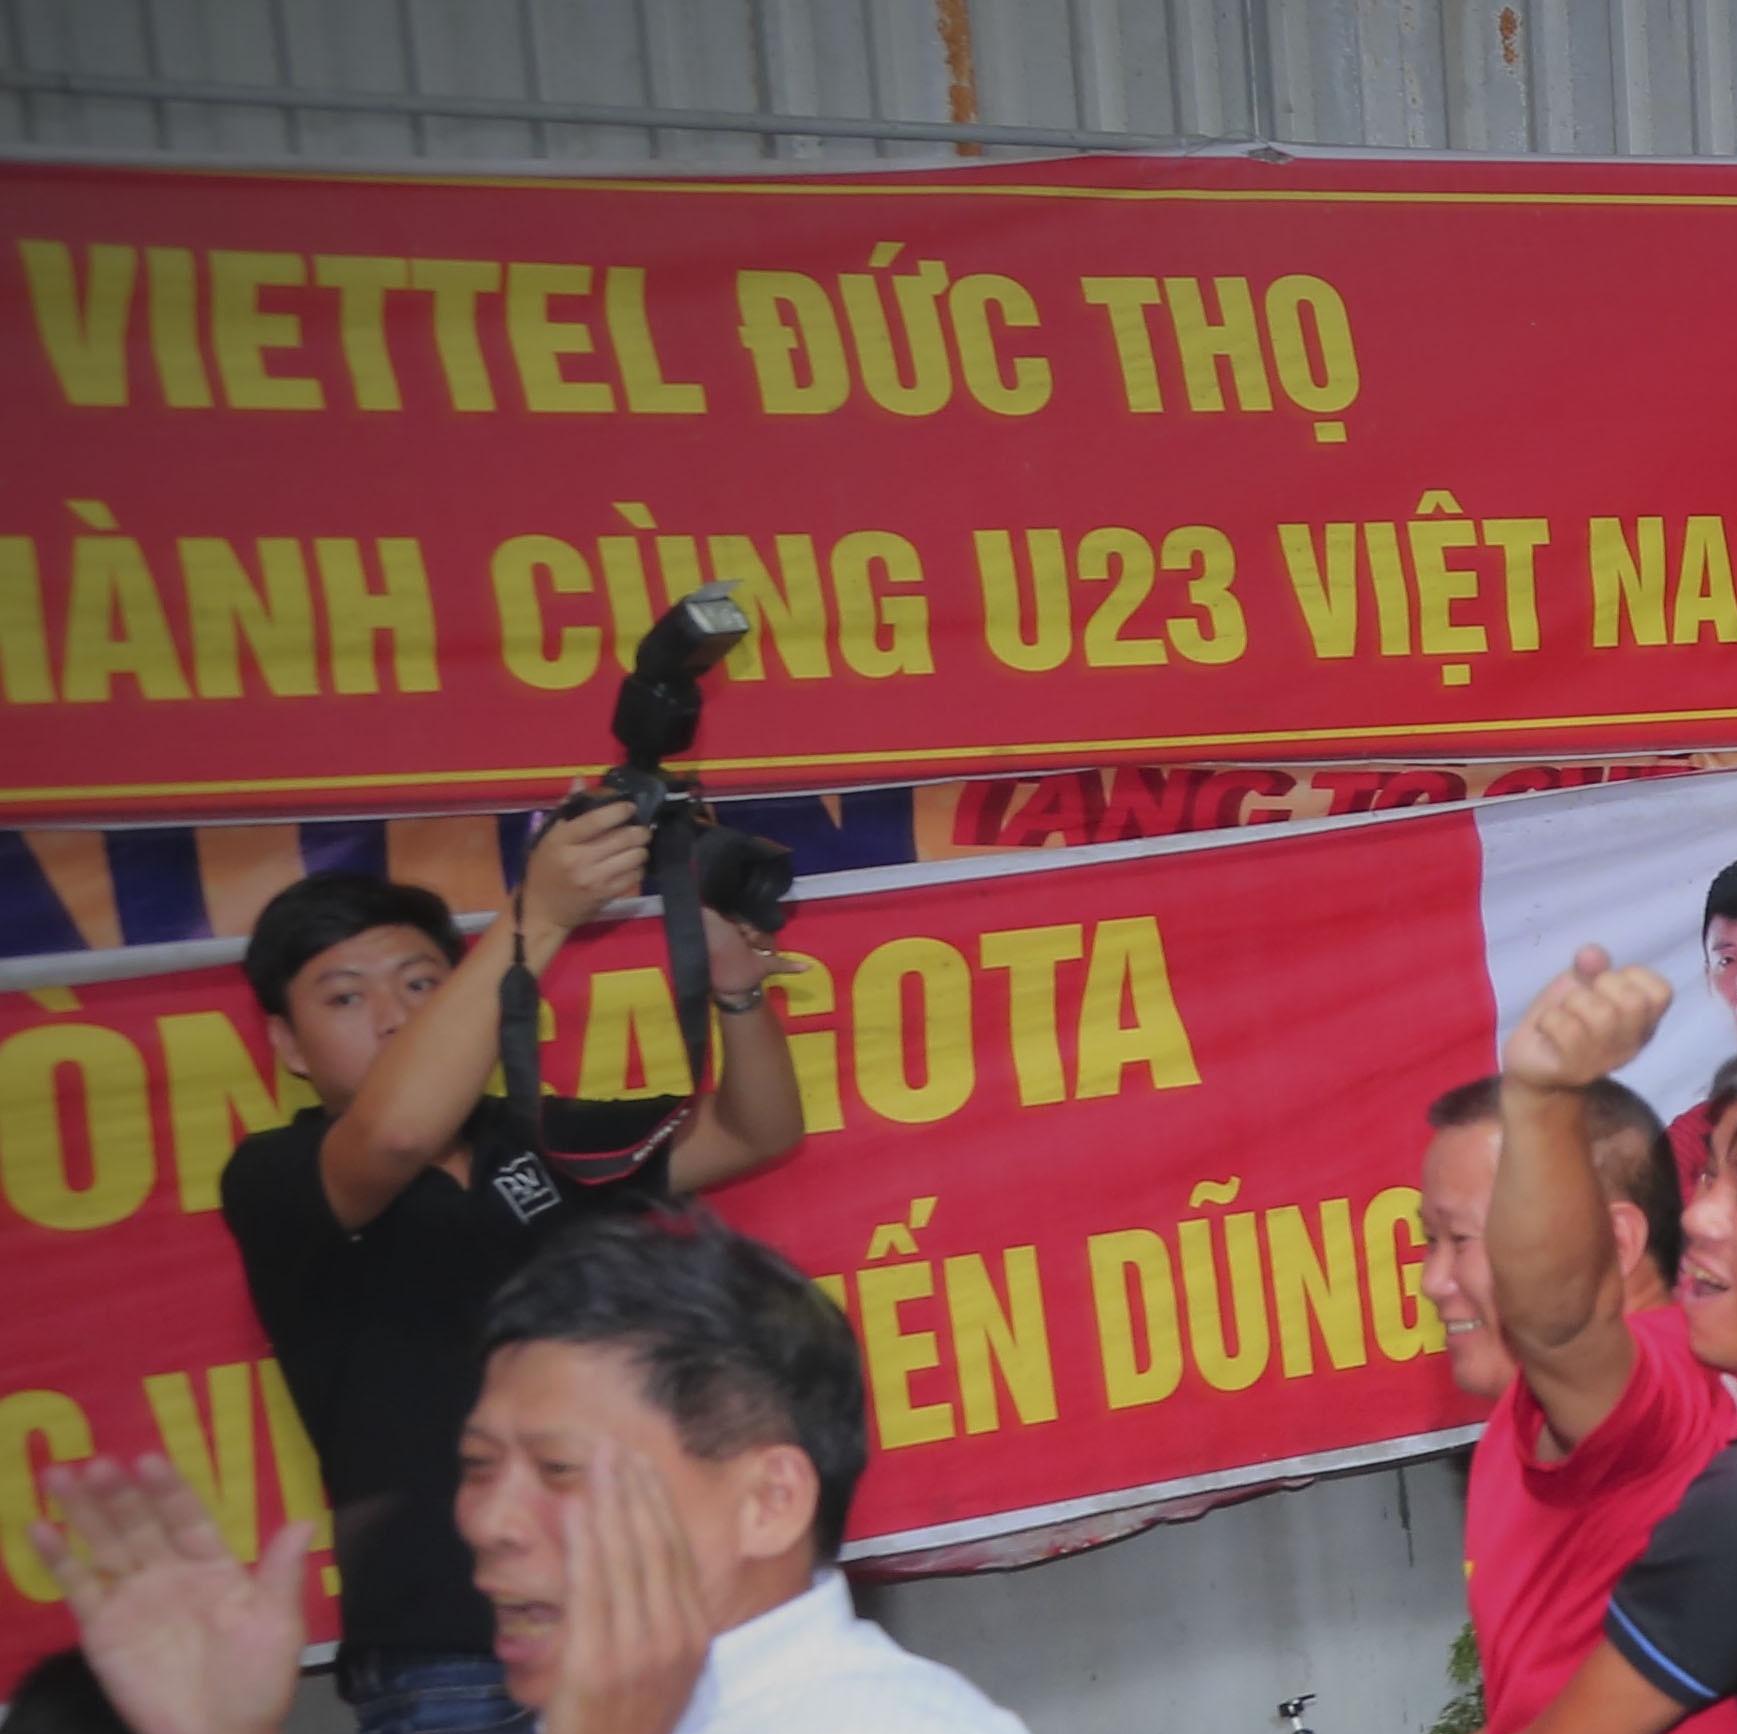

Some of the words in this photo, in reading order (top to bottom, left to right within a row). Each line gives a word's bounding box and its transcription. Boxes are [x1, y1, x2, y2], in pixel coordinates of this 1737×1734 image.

[17, 238, 708, 415] VIETTEL
[737, 241, 1054, 417] ĐỨC
[1080, 273, 1361, 443] THỌ
[490, 502, 935, 690] CÙNG
[975, 524, 1250, 672] U23
[1277, 490, 1551, 687] VIỆT
[1087, 1175, 1449, 1410] DŨNG
